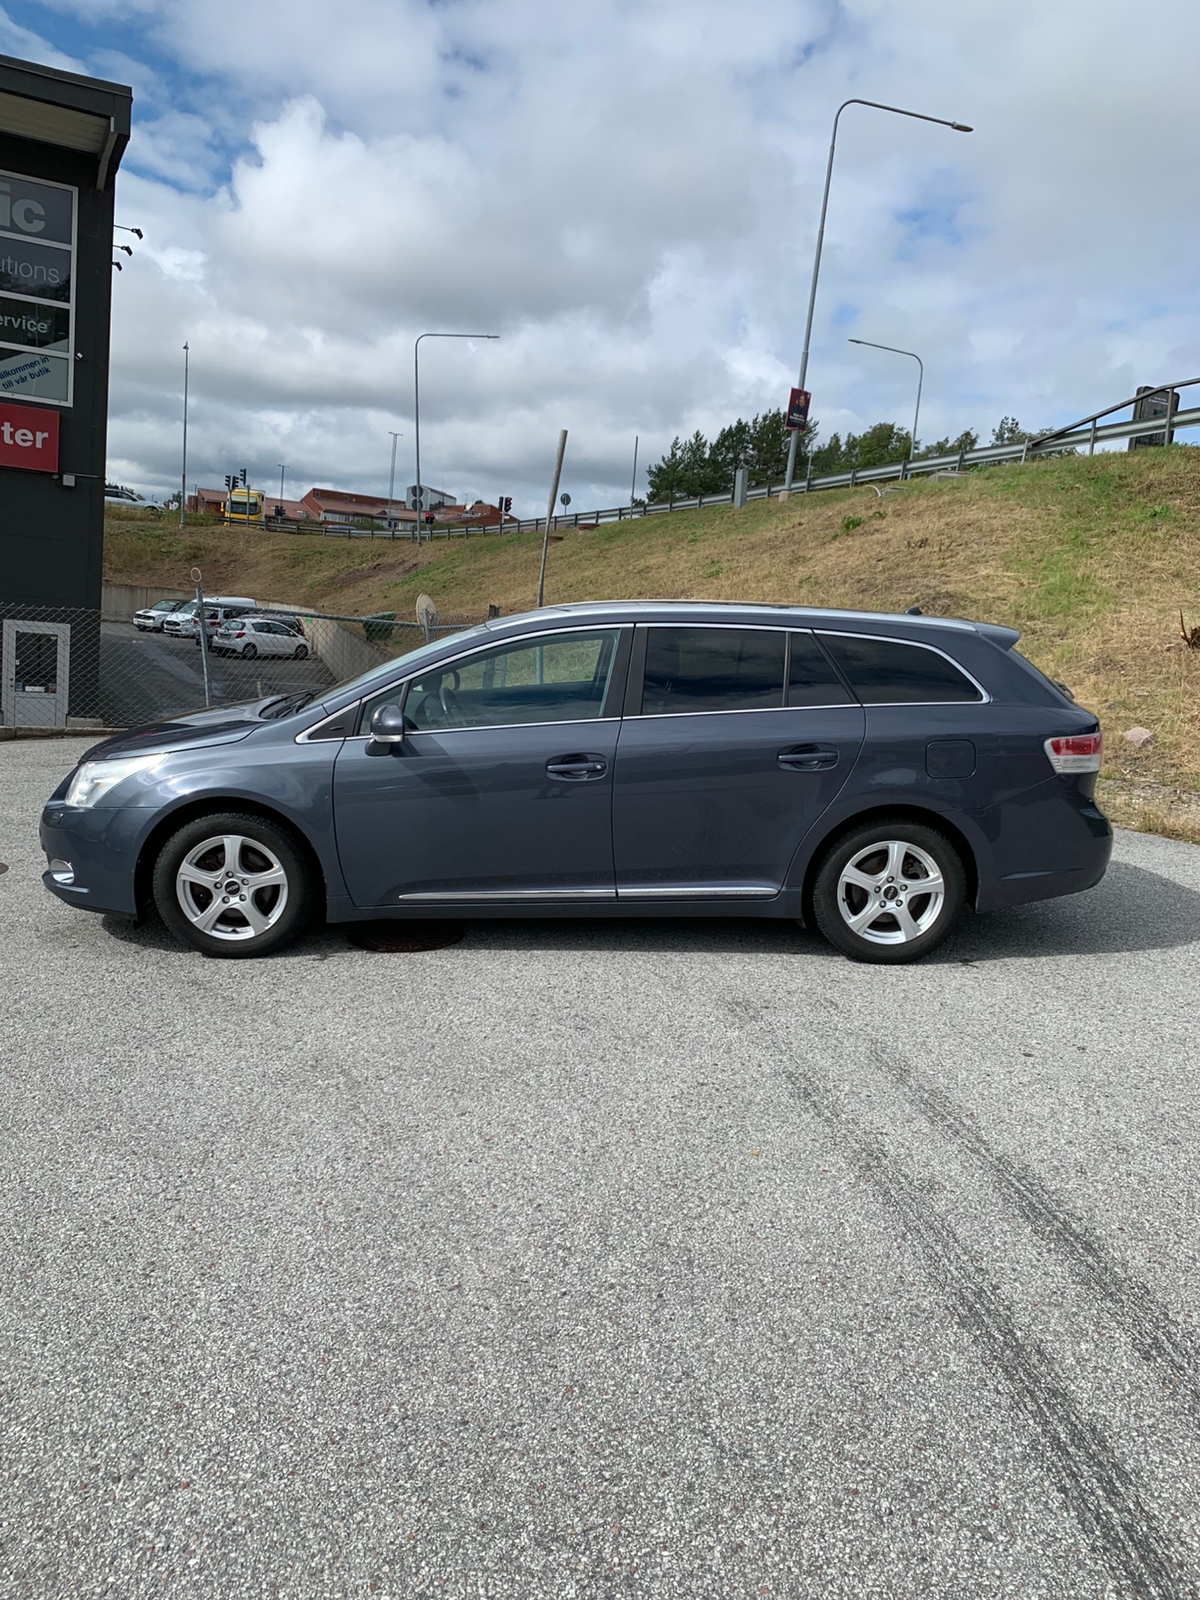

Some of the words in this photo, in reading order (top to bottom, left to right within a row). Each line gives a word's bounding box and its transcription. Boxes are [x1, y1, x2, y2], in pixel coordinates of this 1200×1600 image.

[40, 356, 50, 364] in
[2, 380, 15, 390] till
[14, 375, 28, 385] vår
[29, 367, 51, 380] butik
[1, 421, 49, 449] ter
